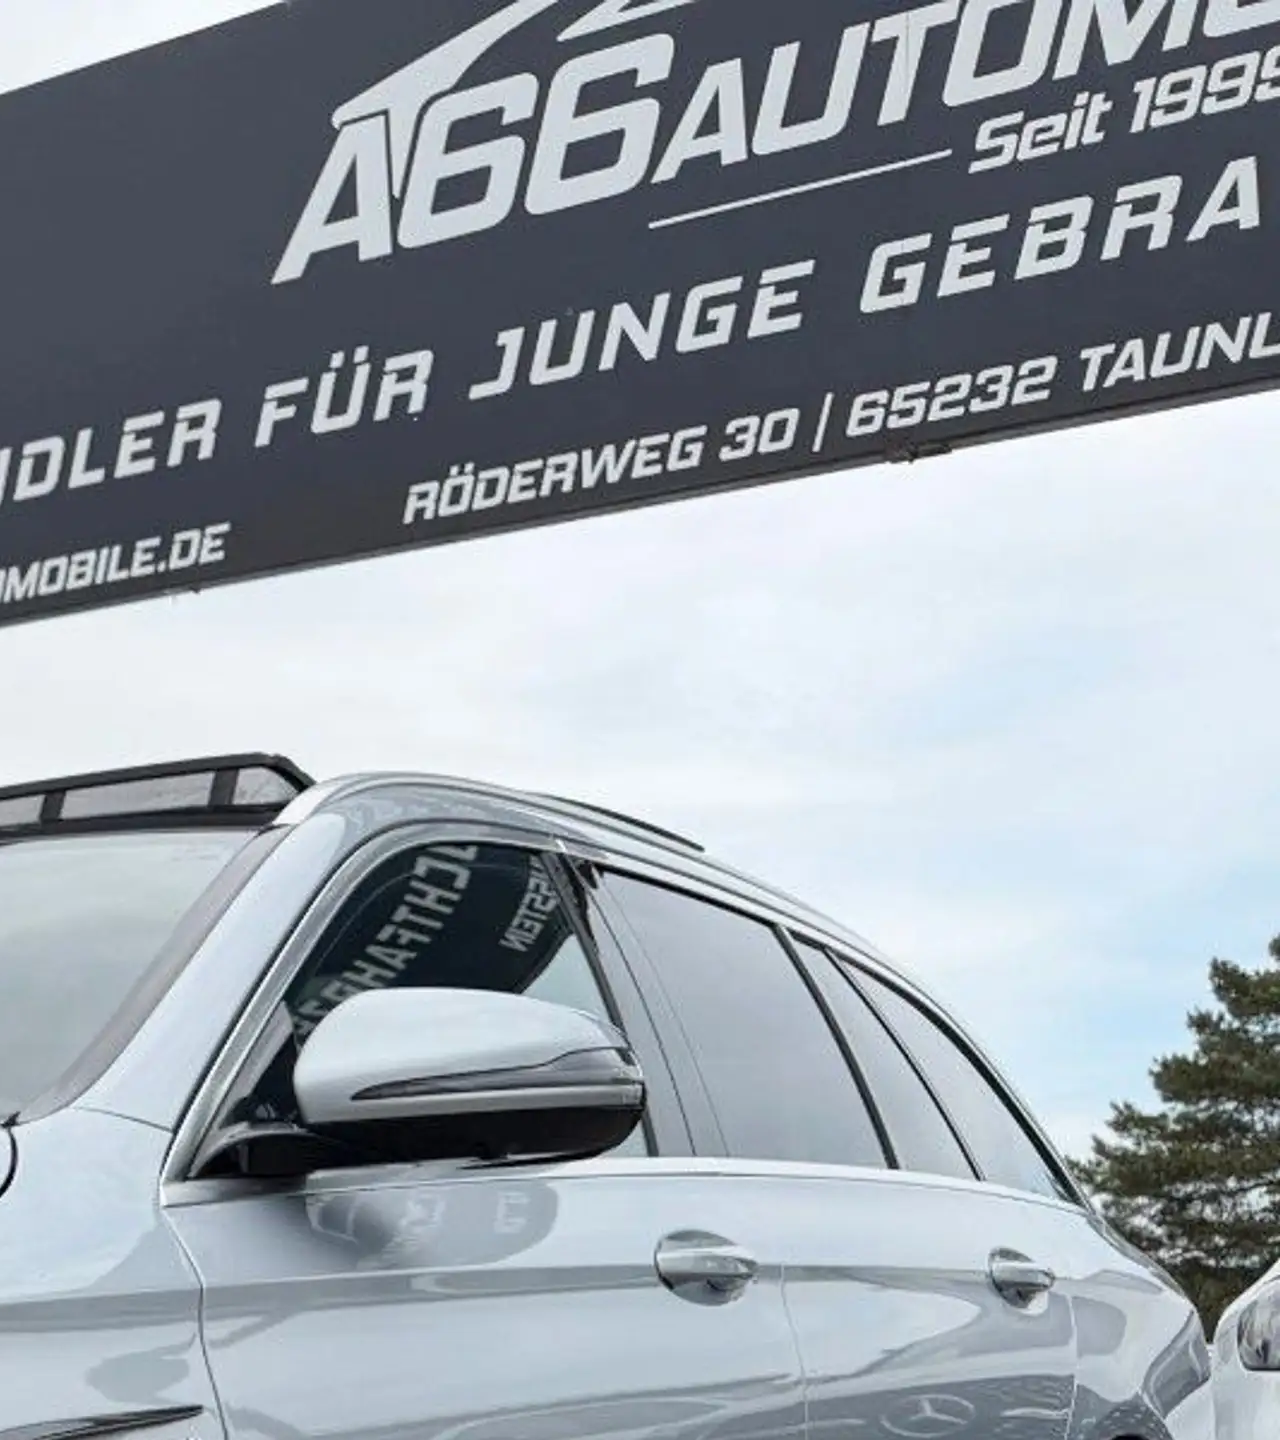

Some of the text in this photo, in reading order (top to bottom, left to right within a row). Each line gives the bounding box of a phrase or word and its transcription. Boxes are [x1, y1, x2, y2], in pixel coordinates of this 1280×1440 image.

[968, 91, 1113, 174] Seit
[254, 345, 434, 448] FÜR
[468, 258, 817, 402] JUNGE
[859, 156, 1261, 314] GEBRA
[403, 421, 708, 525] RÖDERWEG
[719, 406, 801, 454] 30
[846, 355, 1058, 438] 65232
